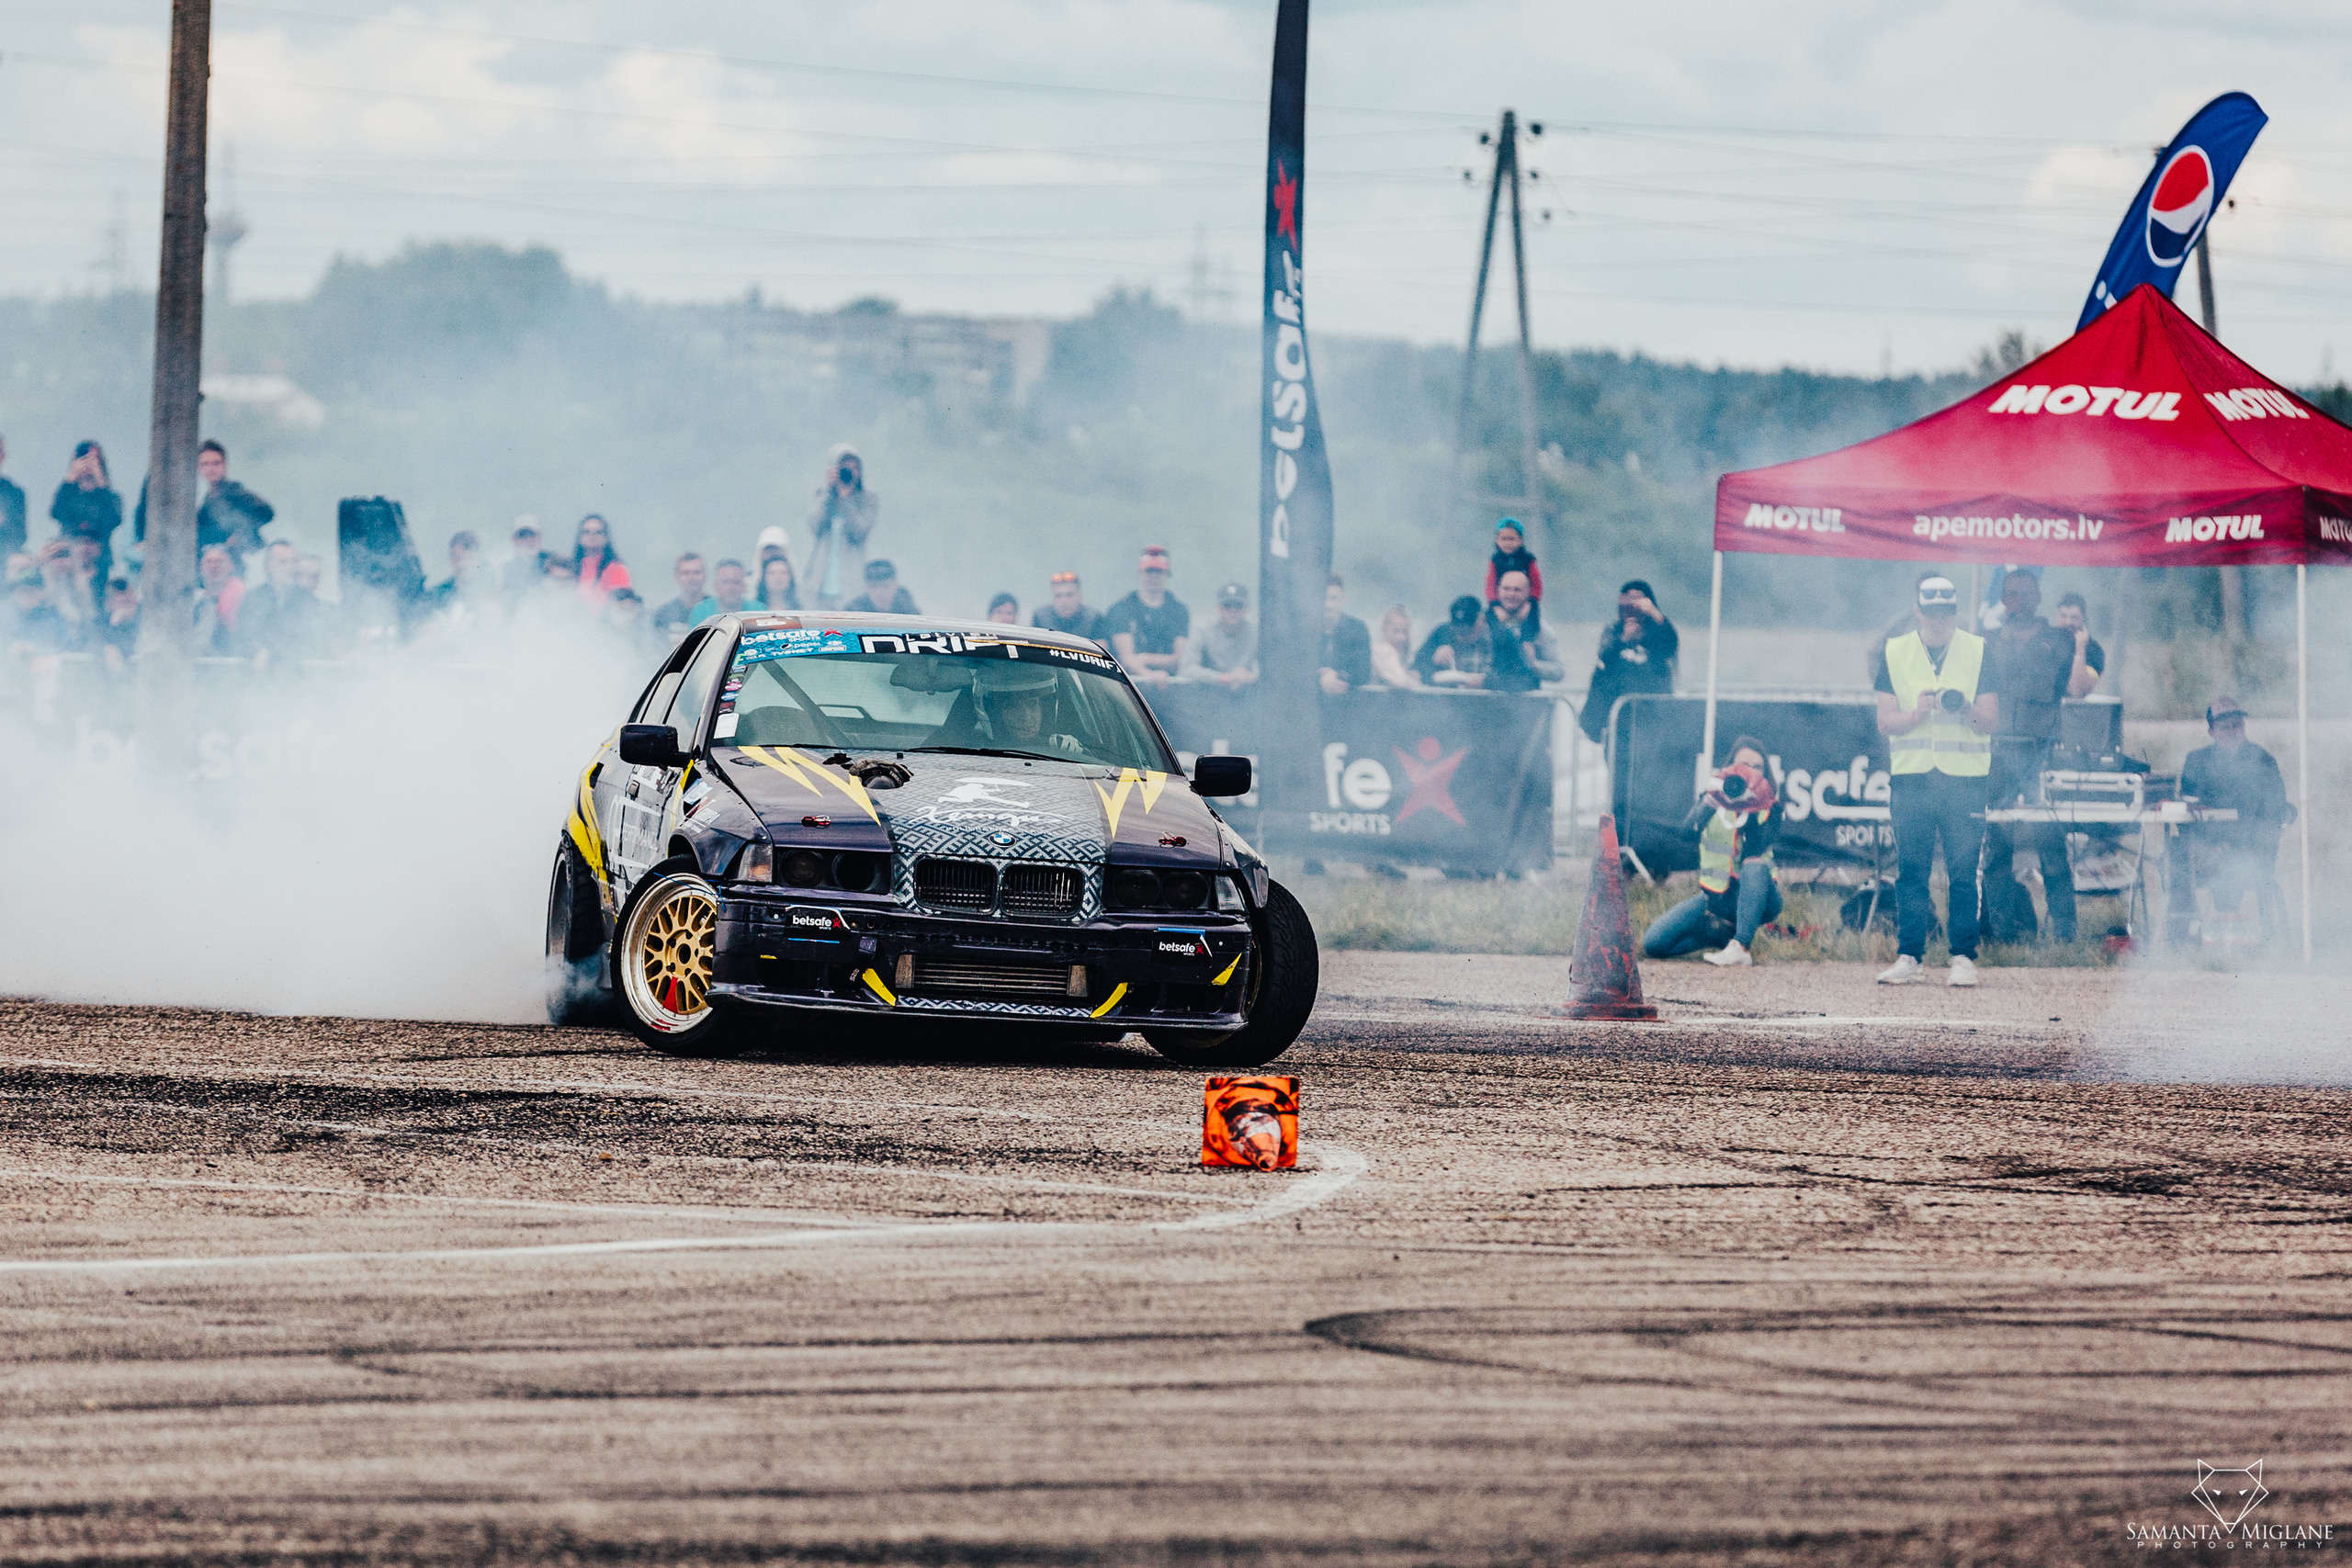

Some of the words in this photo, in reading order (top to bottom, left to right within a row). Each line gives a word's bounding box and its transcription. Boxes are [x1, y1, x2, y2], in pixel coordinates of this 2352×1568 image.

[1988, 384, 2182, 421] MOTUL
[2203, 388, 2311, 422] MOTUL
[1745, 502, 1846, 534] MOTUL
[1913, 513, 2104, 542] apemotors.lv
[2165, 514, 2265, 543] MOTUL
[741, 629, 820, 646] betsafe
[1309, 811, 1392, 836] SPORTS
[792, 914, 832, 927] betsafe
[1159, 941, 1196, 953] betsafe
